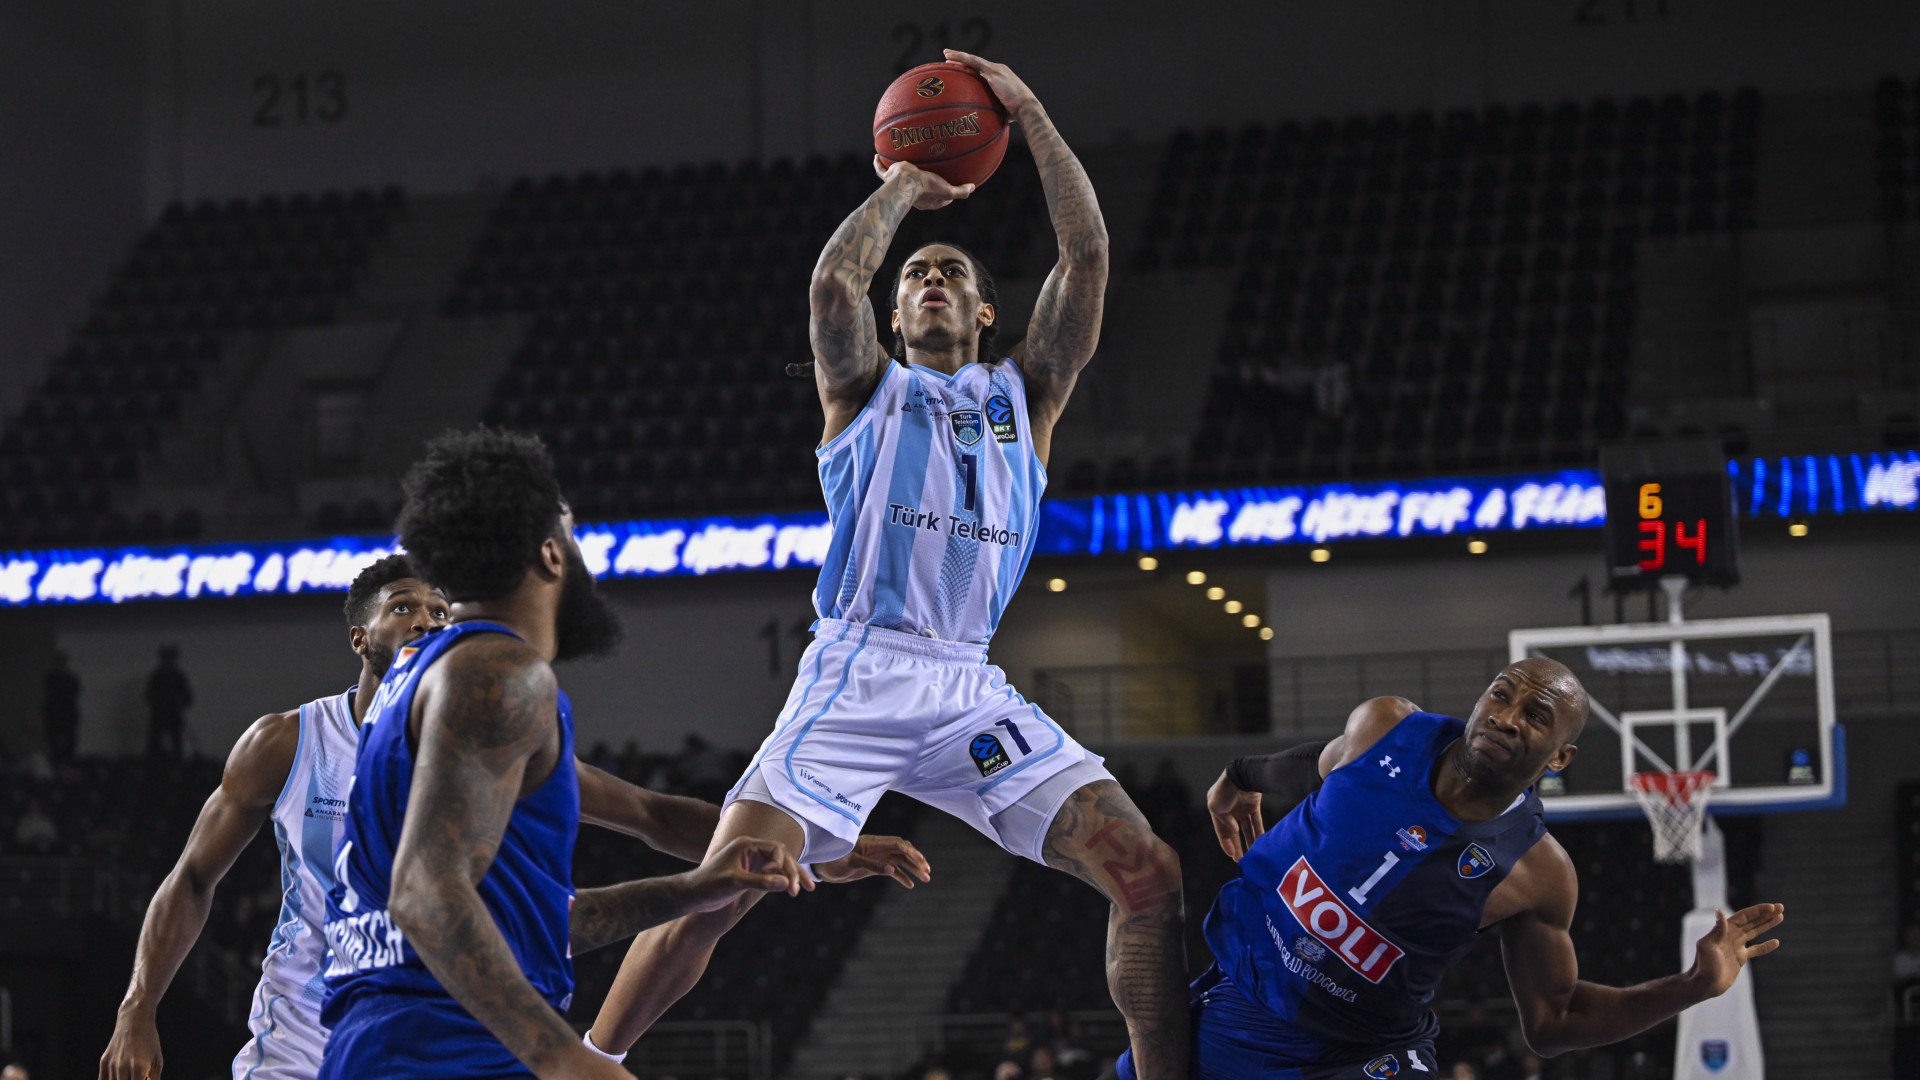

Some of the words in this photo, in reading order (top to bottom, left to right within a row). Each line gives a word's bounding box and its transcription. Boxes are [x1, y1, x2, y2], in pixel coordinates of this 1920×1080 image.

[252, 70, 348, 126] 213
[890, 112, 981, 150] SPALDING
[961, 454, 978, 512] 1
[1638, 482, 1663, 520] 6
[889, 503, 941, 532] Türk
[948, 515, 1020, 547] Telekom
[1638, 518, 1707, 570] 34
[994, 717, 1032, 757] 1
[812, 779, 832, 794] HOSPITAL
[983, 760, 1009, 777] EuroCup
[315, 809, 342, 817] ANKARA
[835, 792, 862, 811] SPORTIVE
[1348, 850, 1400, 906] 1
[1293, 869, 1389, 972] VOLI
[1280, 946, 1303, 974] GRAD
[1300, 963, 1358, 1003] PODGORICA
